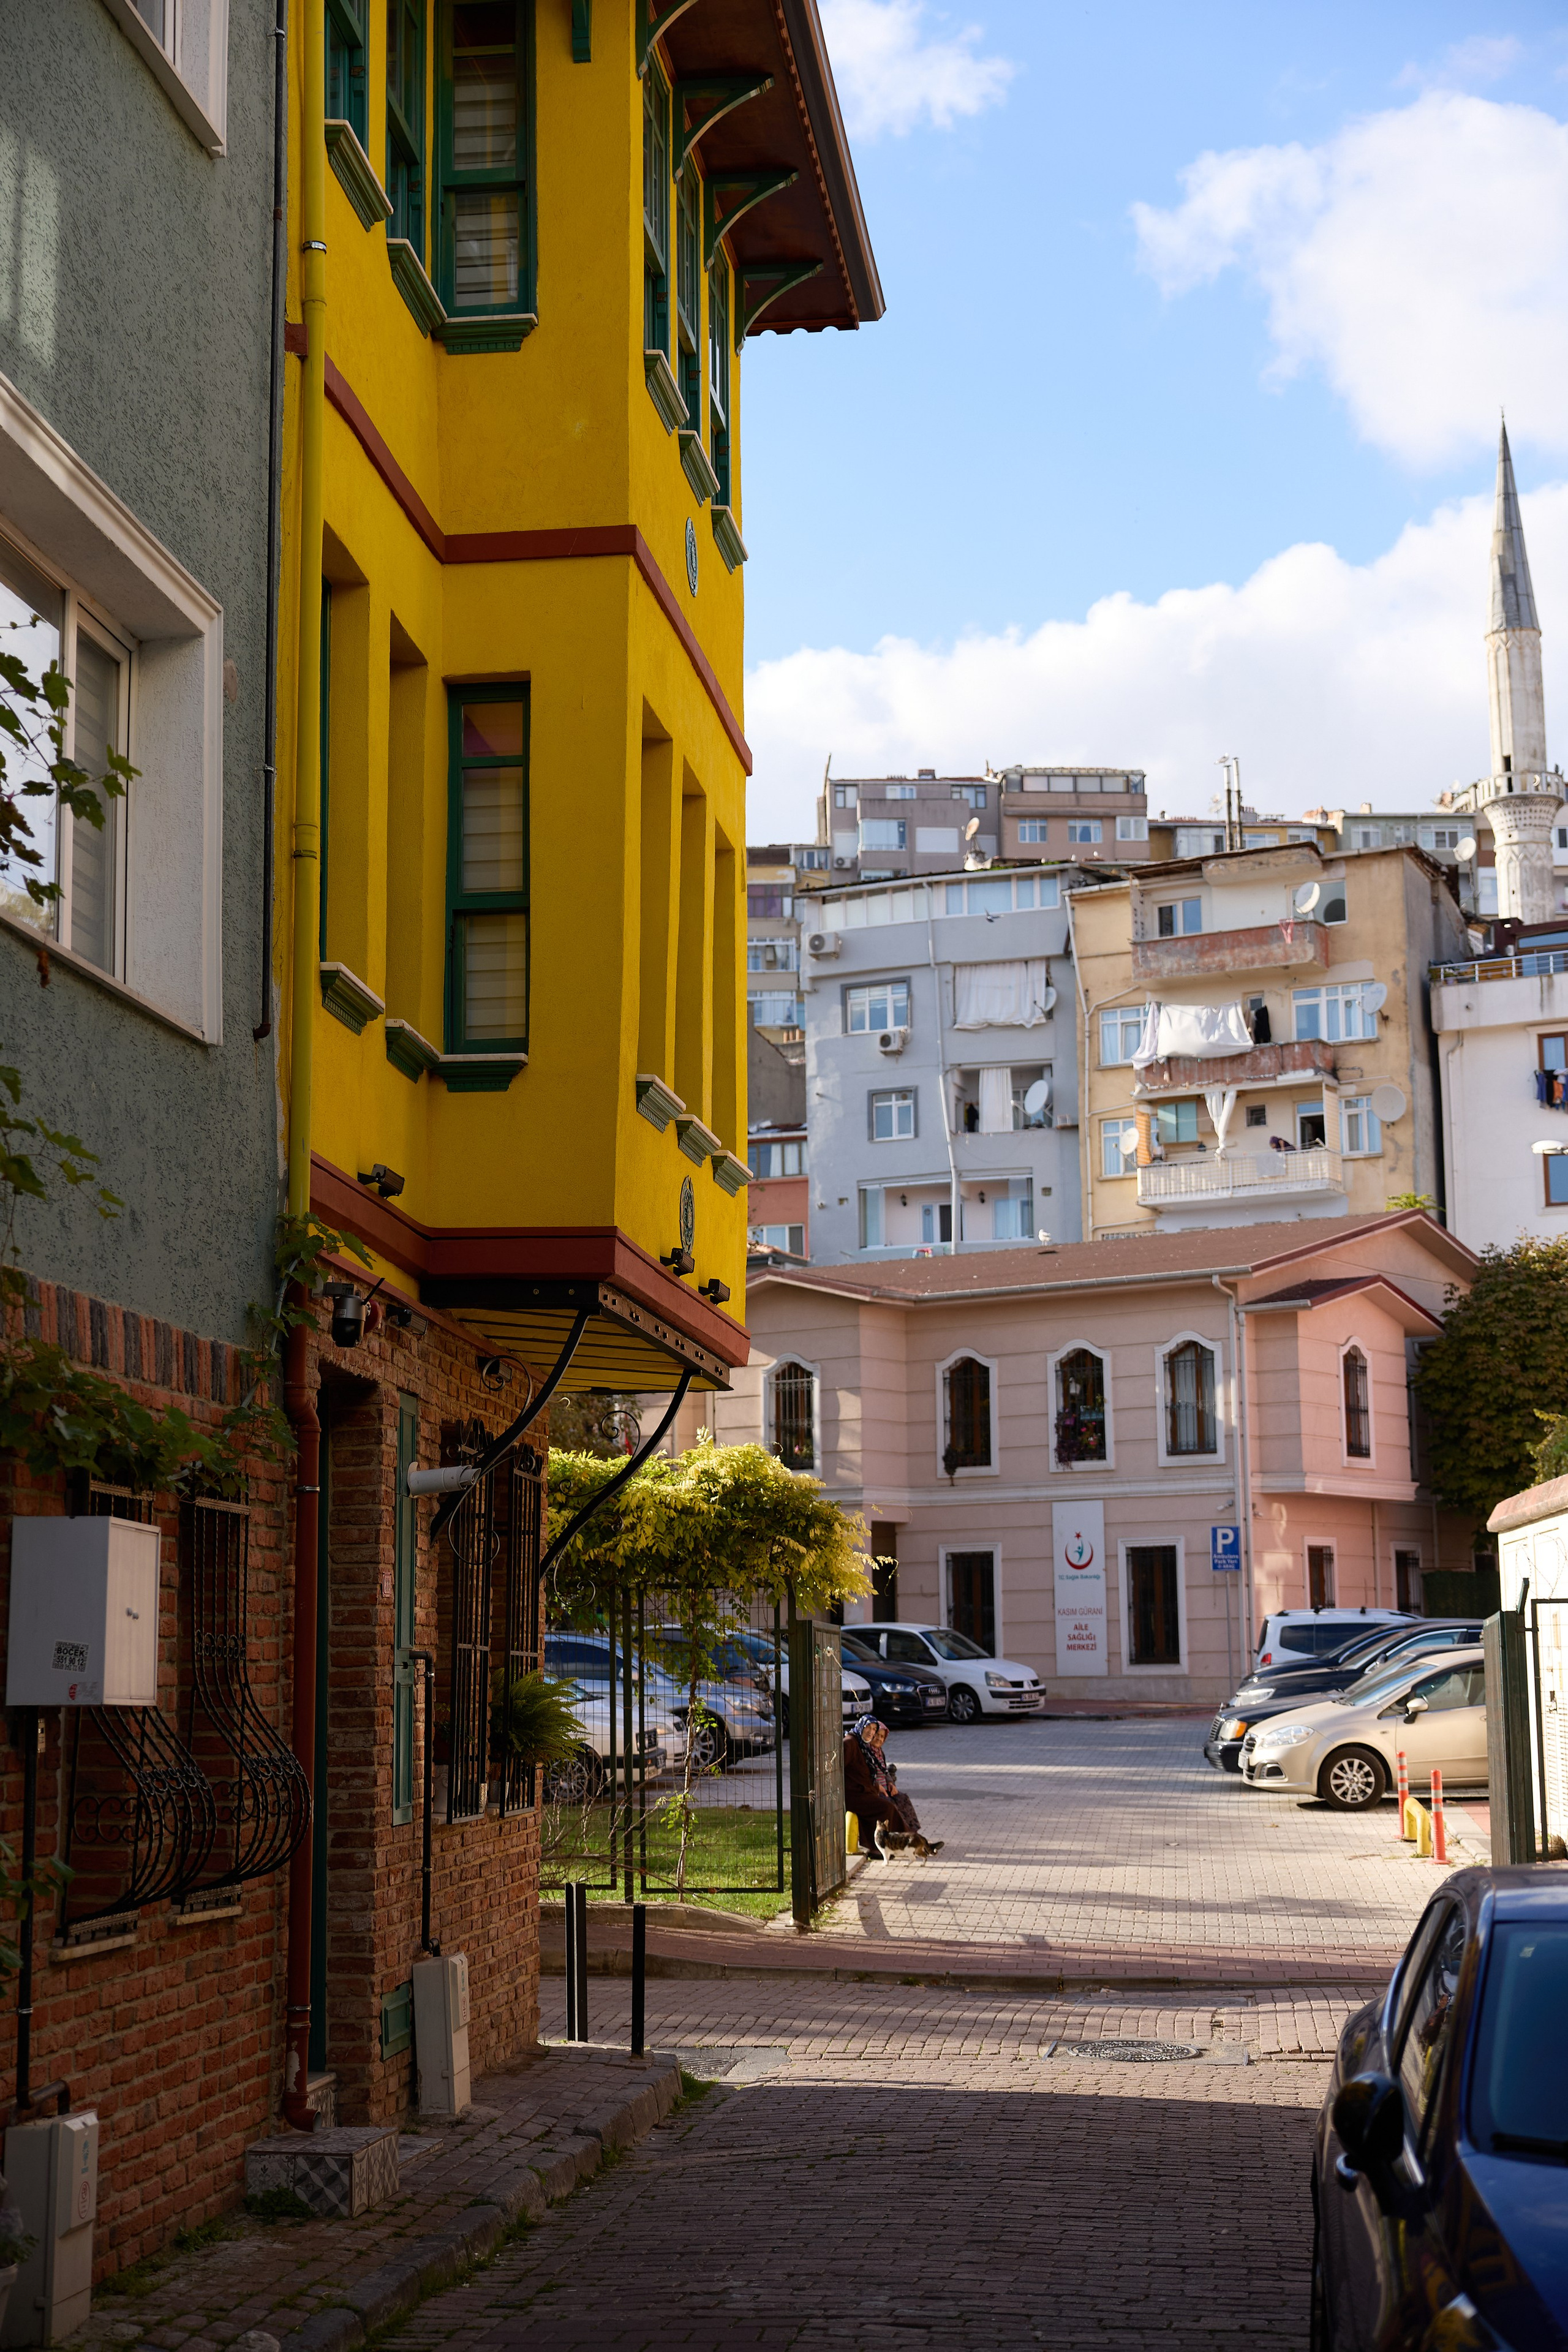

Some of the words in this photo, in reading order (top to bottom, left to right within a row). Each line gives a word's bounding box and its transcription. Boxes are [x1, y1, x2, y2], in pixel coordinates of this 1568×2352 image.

[1216, 1528, 1234, 1553] P
[1073, 1622, 1088, 1630] AİLE
[1067, 1632, 1096, 1641] SAĞLIĞI
[1066, 1642, 1096, 1651] MERKEZİ
[56, 1656, 67, 1664] 551
